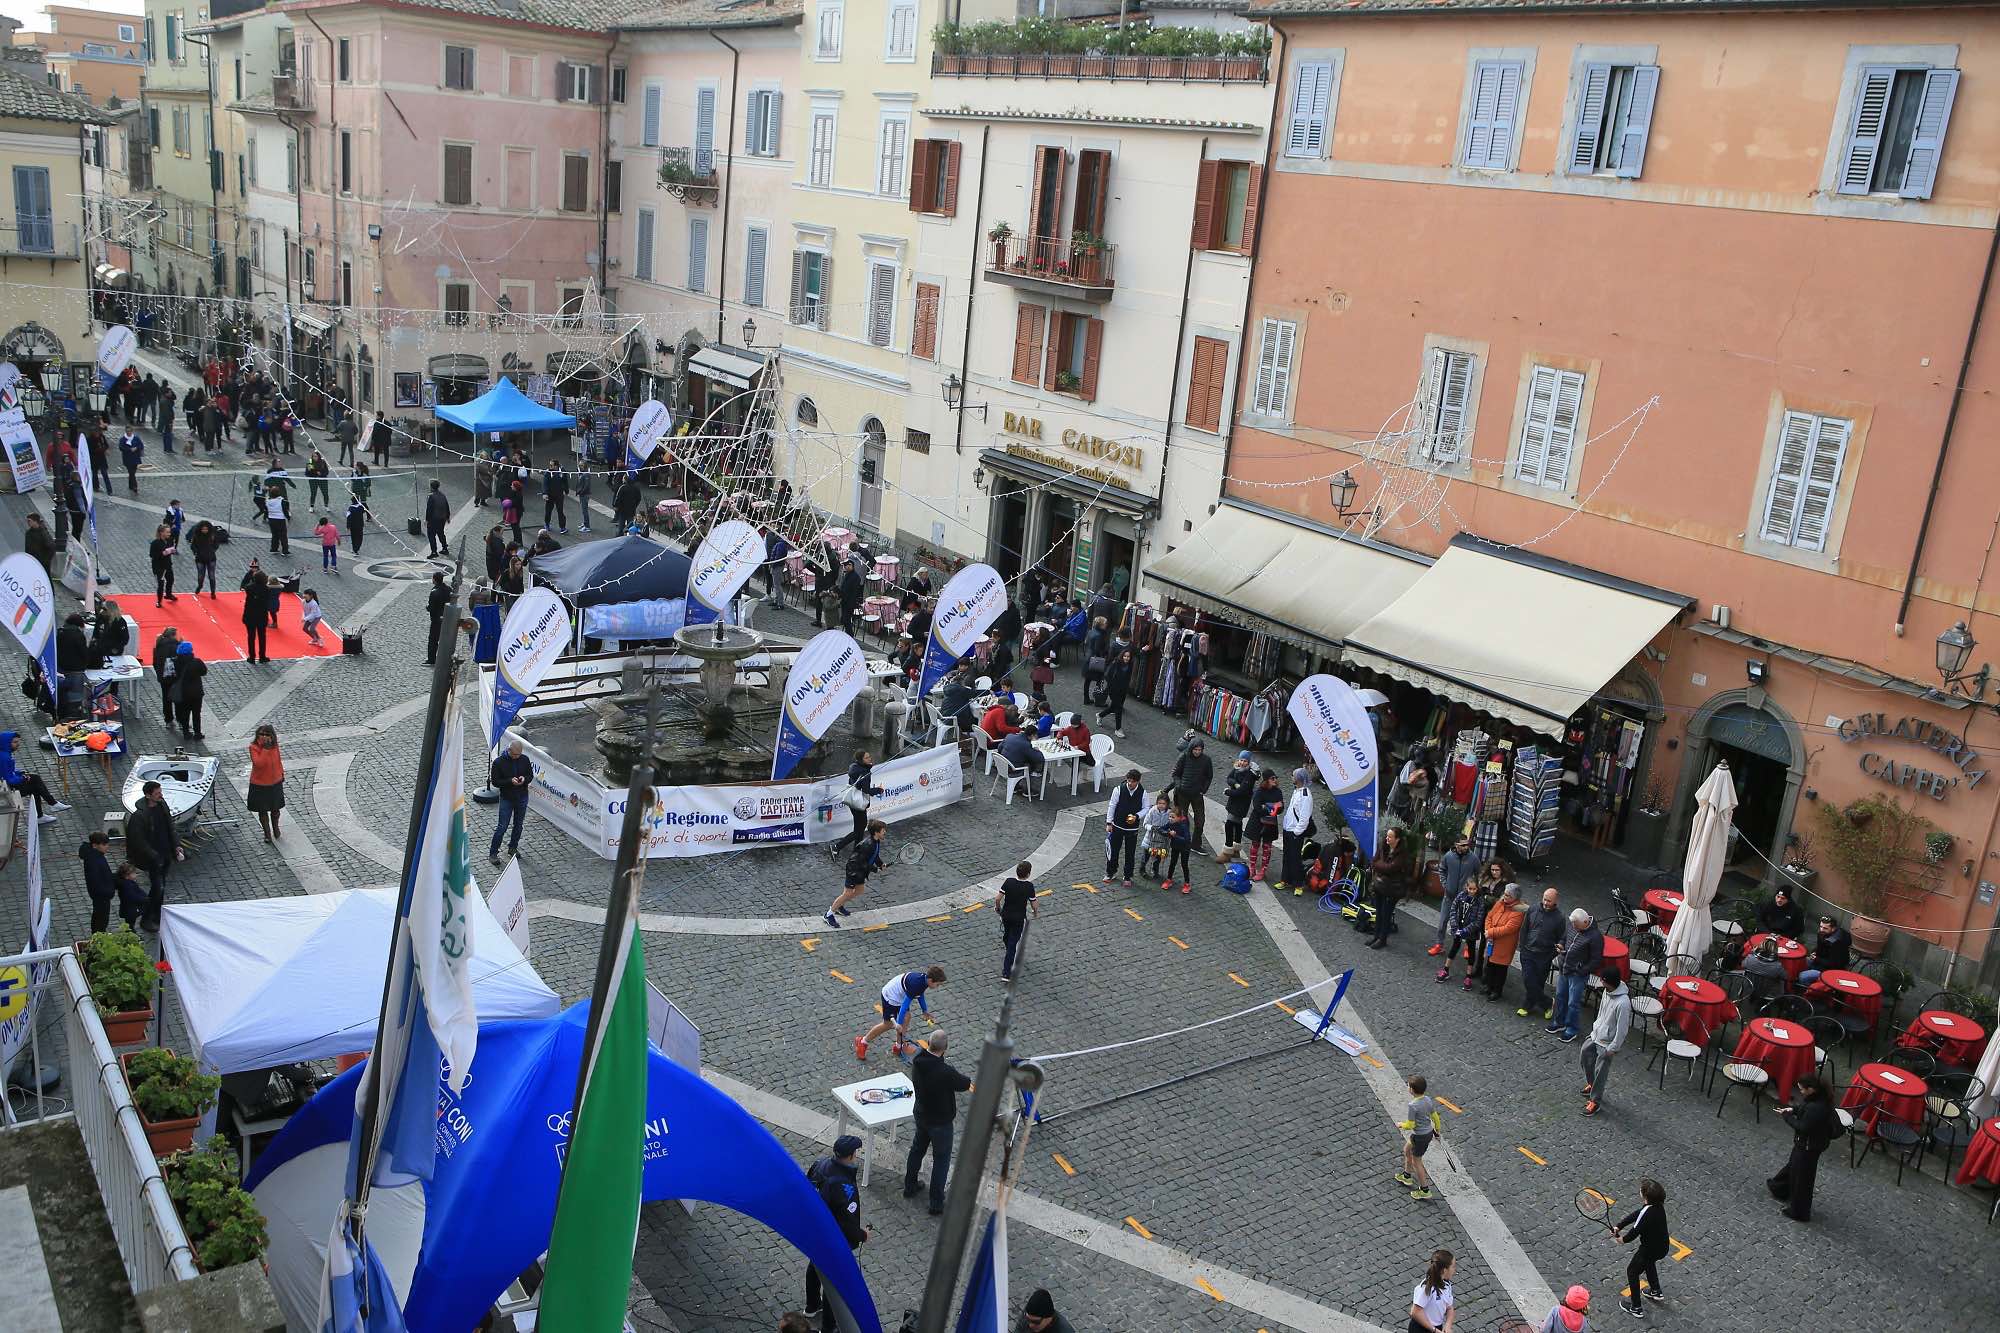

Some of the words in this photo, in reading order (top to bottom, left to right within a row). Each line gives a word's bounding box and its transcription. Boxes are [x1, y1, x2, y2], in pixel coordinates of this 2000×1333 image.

[1003, 411, 1042, 440] BAR
[1061, 428, 1143, 470] CAROSI
[694, 564, 715, 587] CONI
[938, 606, 959, 629] CONI
[964, 577, 997, 610] Regione
[503, 639, 523, 663] CONI
[529, 602, 560, 641] Regione
[792, 680, 813, 706] CONI
[819, 645, 854, 686] Regione
[1839, 712, 1990, 790] GELATERIA
[783, 795, 805, 805] ROMA
[885, 782, 914, 798] Regione
[666, 812, 729, 827] Regione
[760, 802, 805, 815] CAPITALE
[674, 829, 689, 844] di
[692, 831, 728, 846] sport
[748, 832, 771, 841] Radio
[1328, 856, 1339, 884] HEAD
[447, 1107, 474, 1144] CONI
